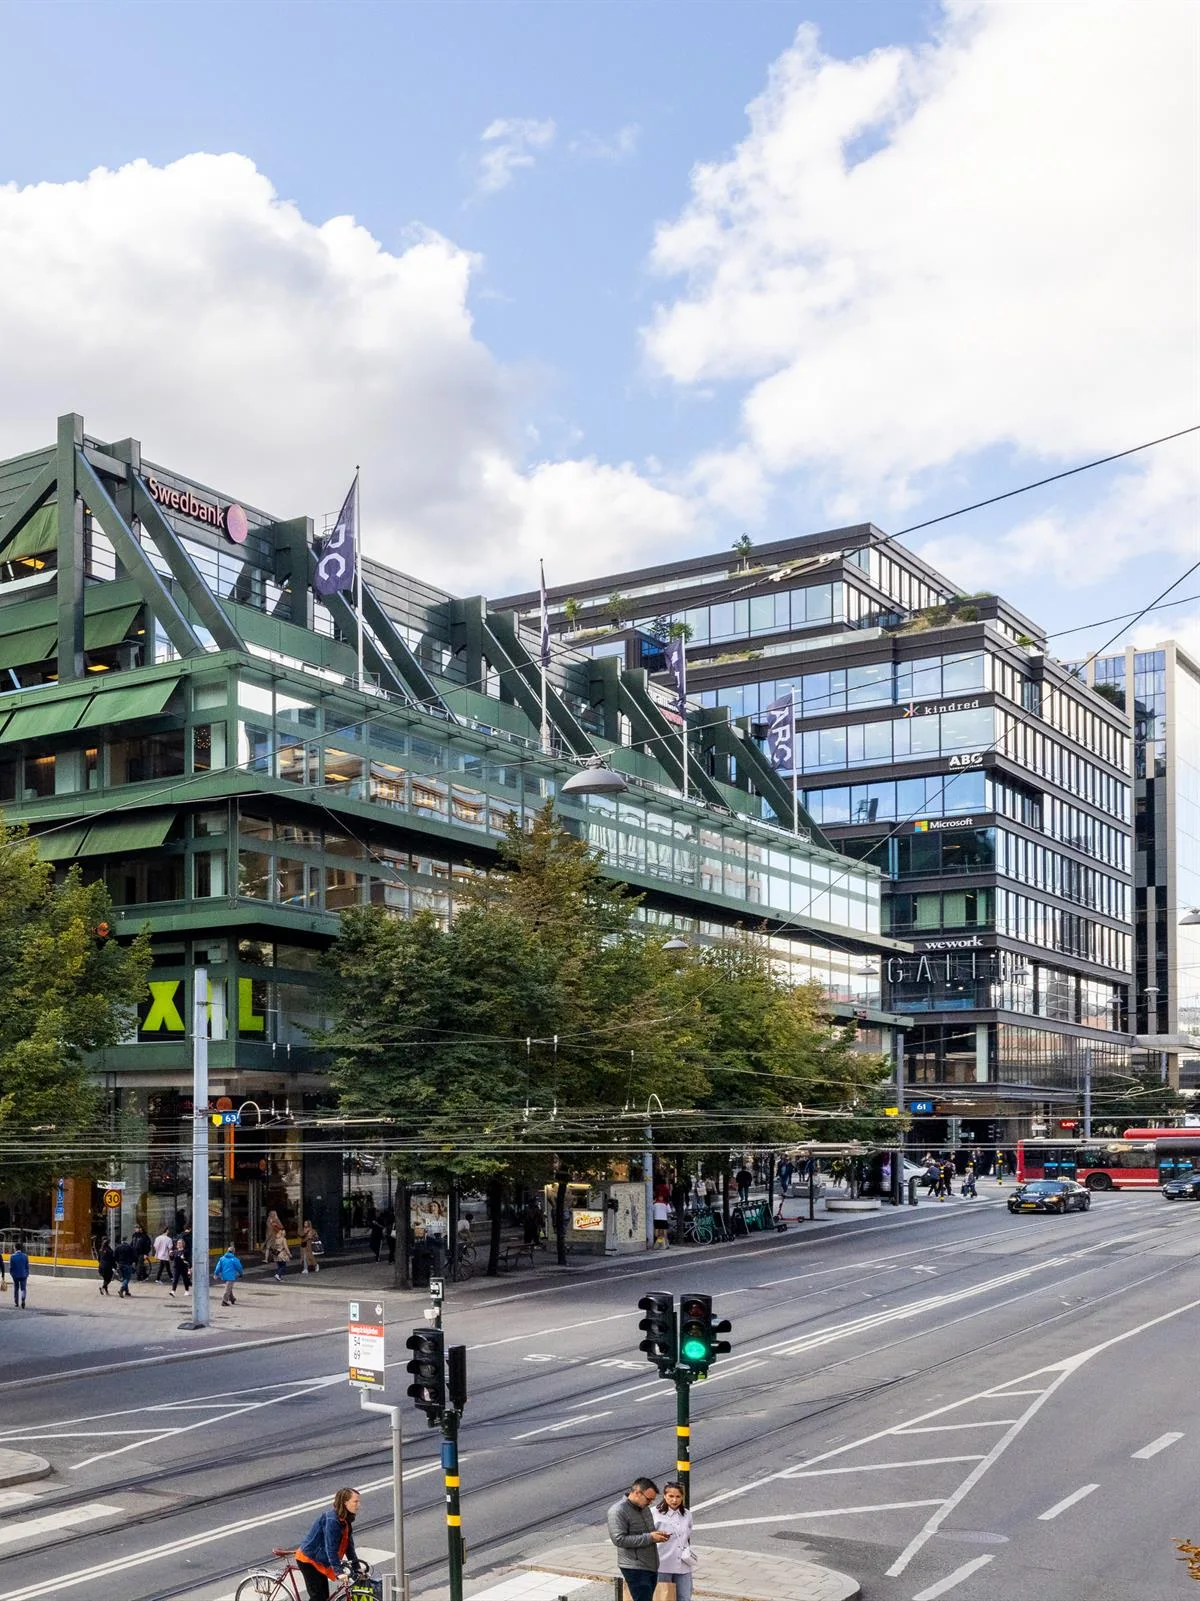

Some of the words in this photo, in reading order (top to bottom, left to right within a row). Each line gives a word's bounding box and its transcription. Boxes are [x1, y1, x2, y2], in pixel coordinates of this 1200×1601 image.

[148, 476, 225, 529] Swedbank
[924, 699, 979, 715] kindred
[949, 753, 983, 767] ABG
[929, 817, 973, 830] Microsoft
[925, 935, 984, 950] wework
[916, 1103, 927, 1111] 61
[225, 1114, 237, 1123] 63
[107, 1195, 120, 1204] 30
